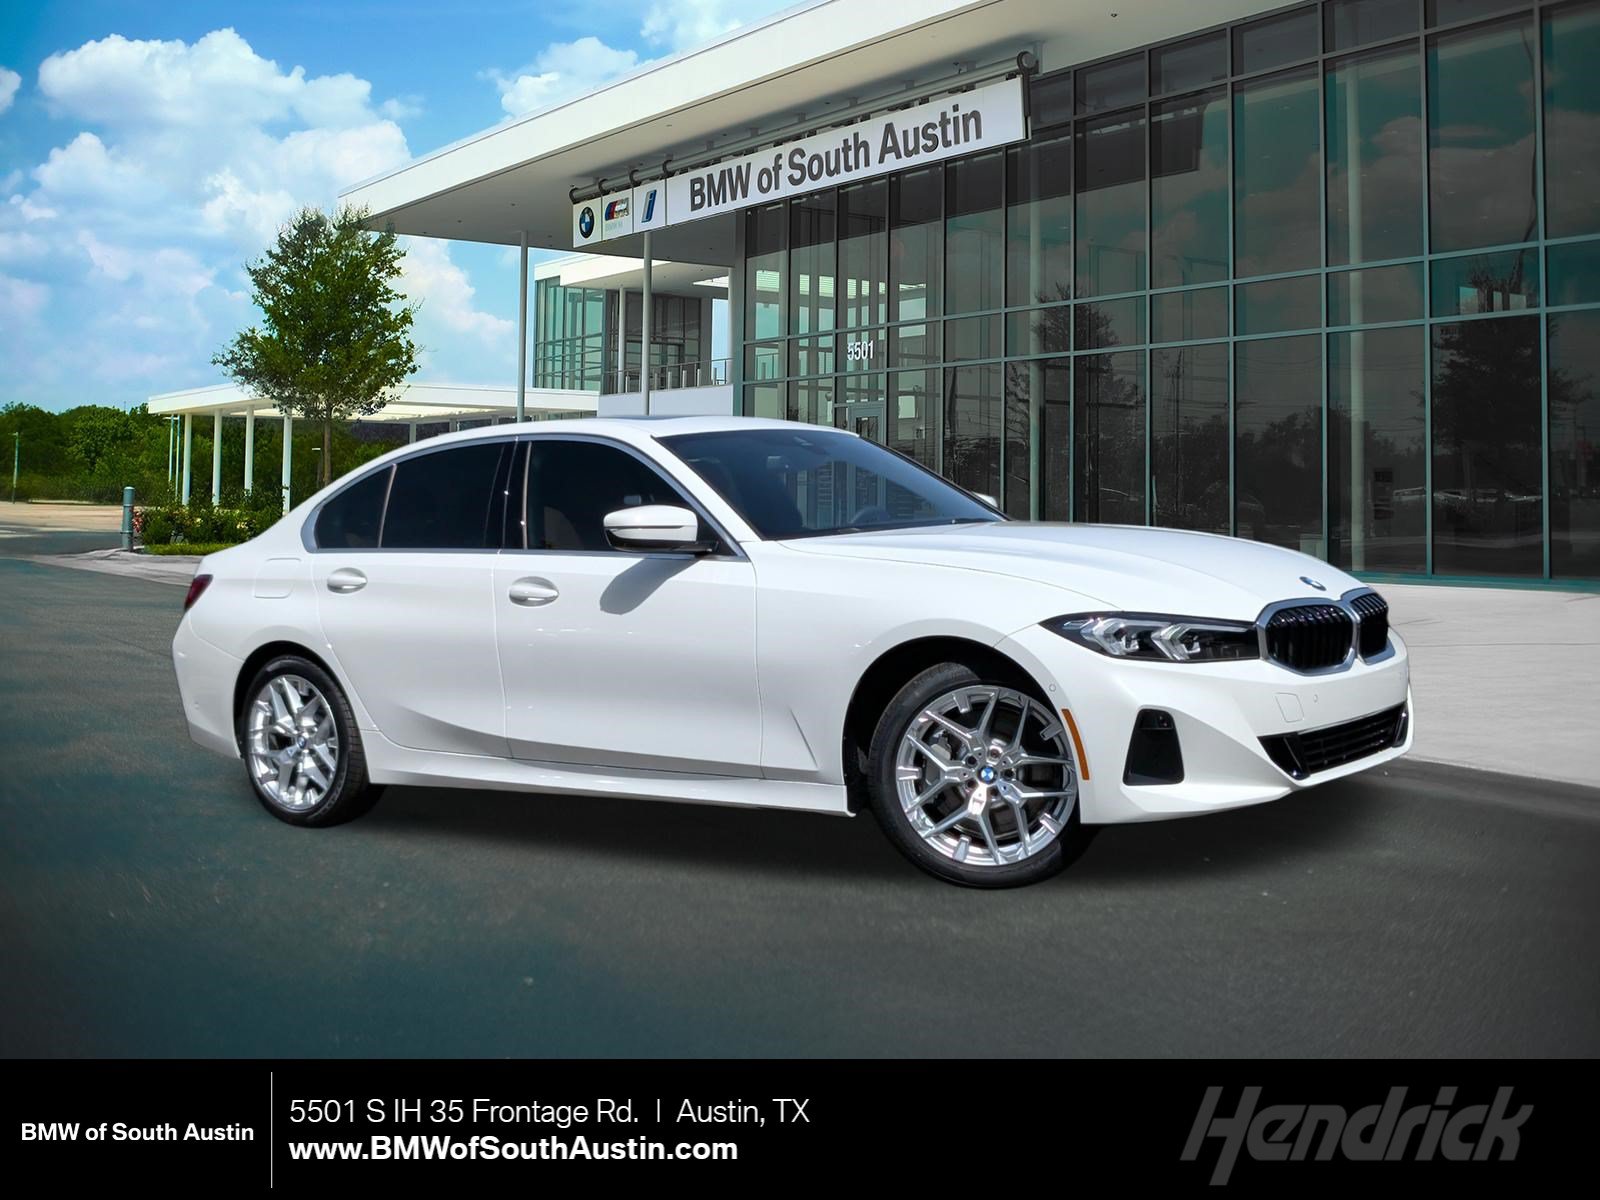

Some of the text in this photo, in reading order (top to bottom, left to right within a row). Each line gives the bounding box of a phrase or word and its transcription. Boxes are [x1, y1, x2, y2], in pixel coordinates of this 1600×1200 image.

[690, 163, 751, 211] BMW
[757, 153, 783, 194] of
[787, 132, 870, 186] South
[878, 104, 982, 164] Austin
[847, 340, 874, 360] 5501
